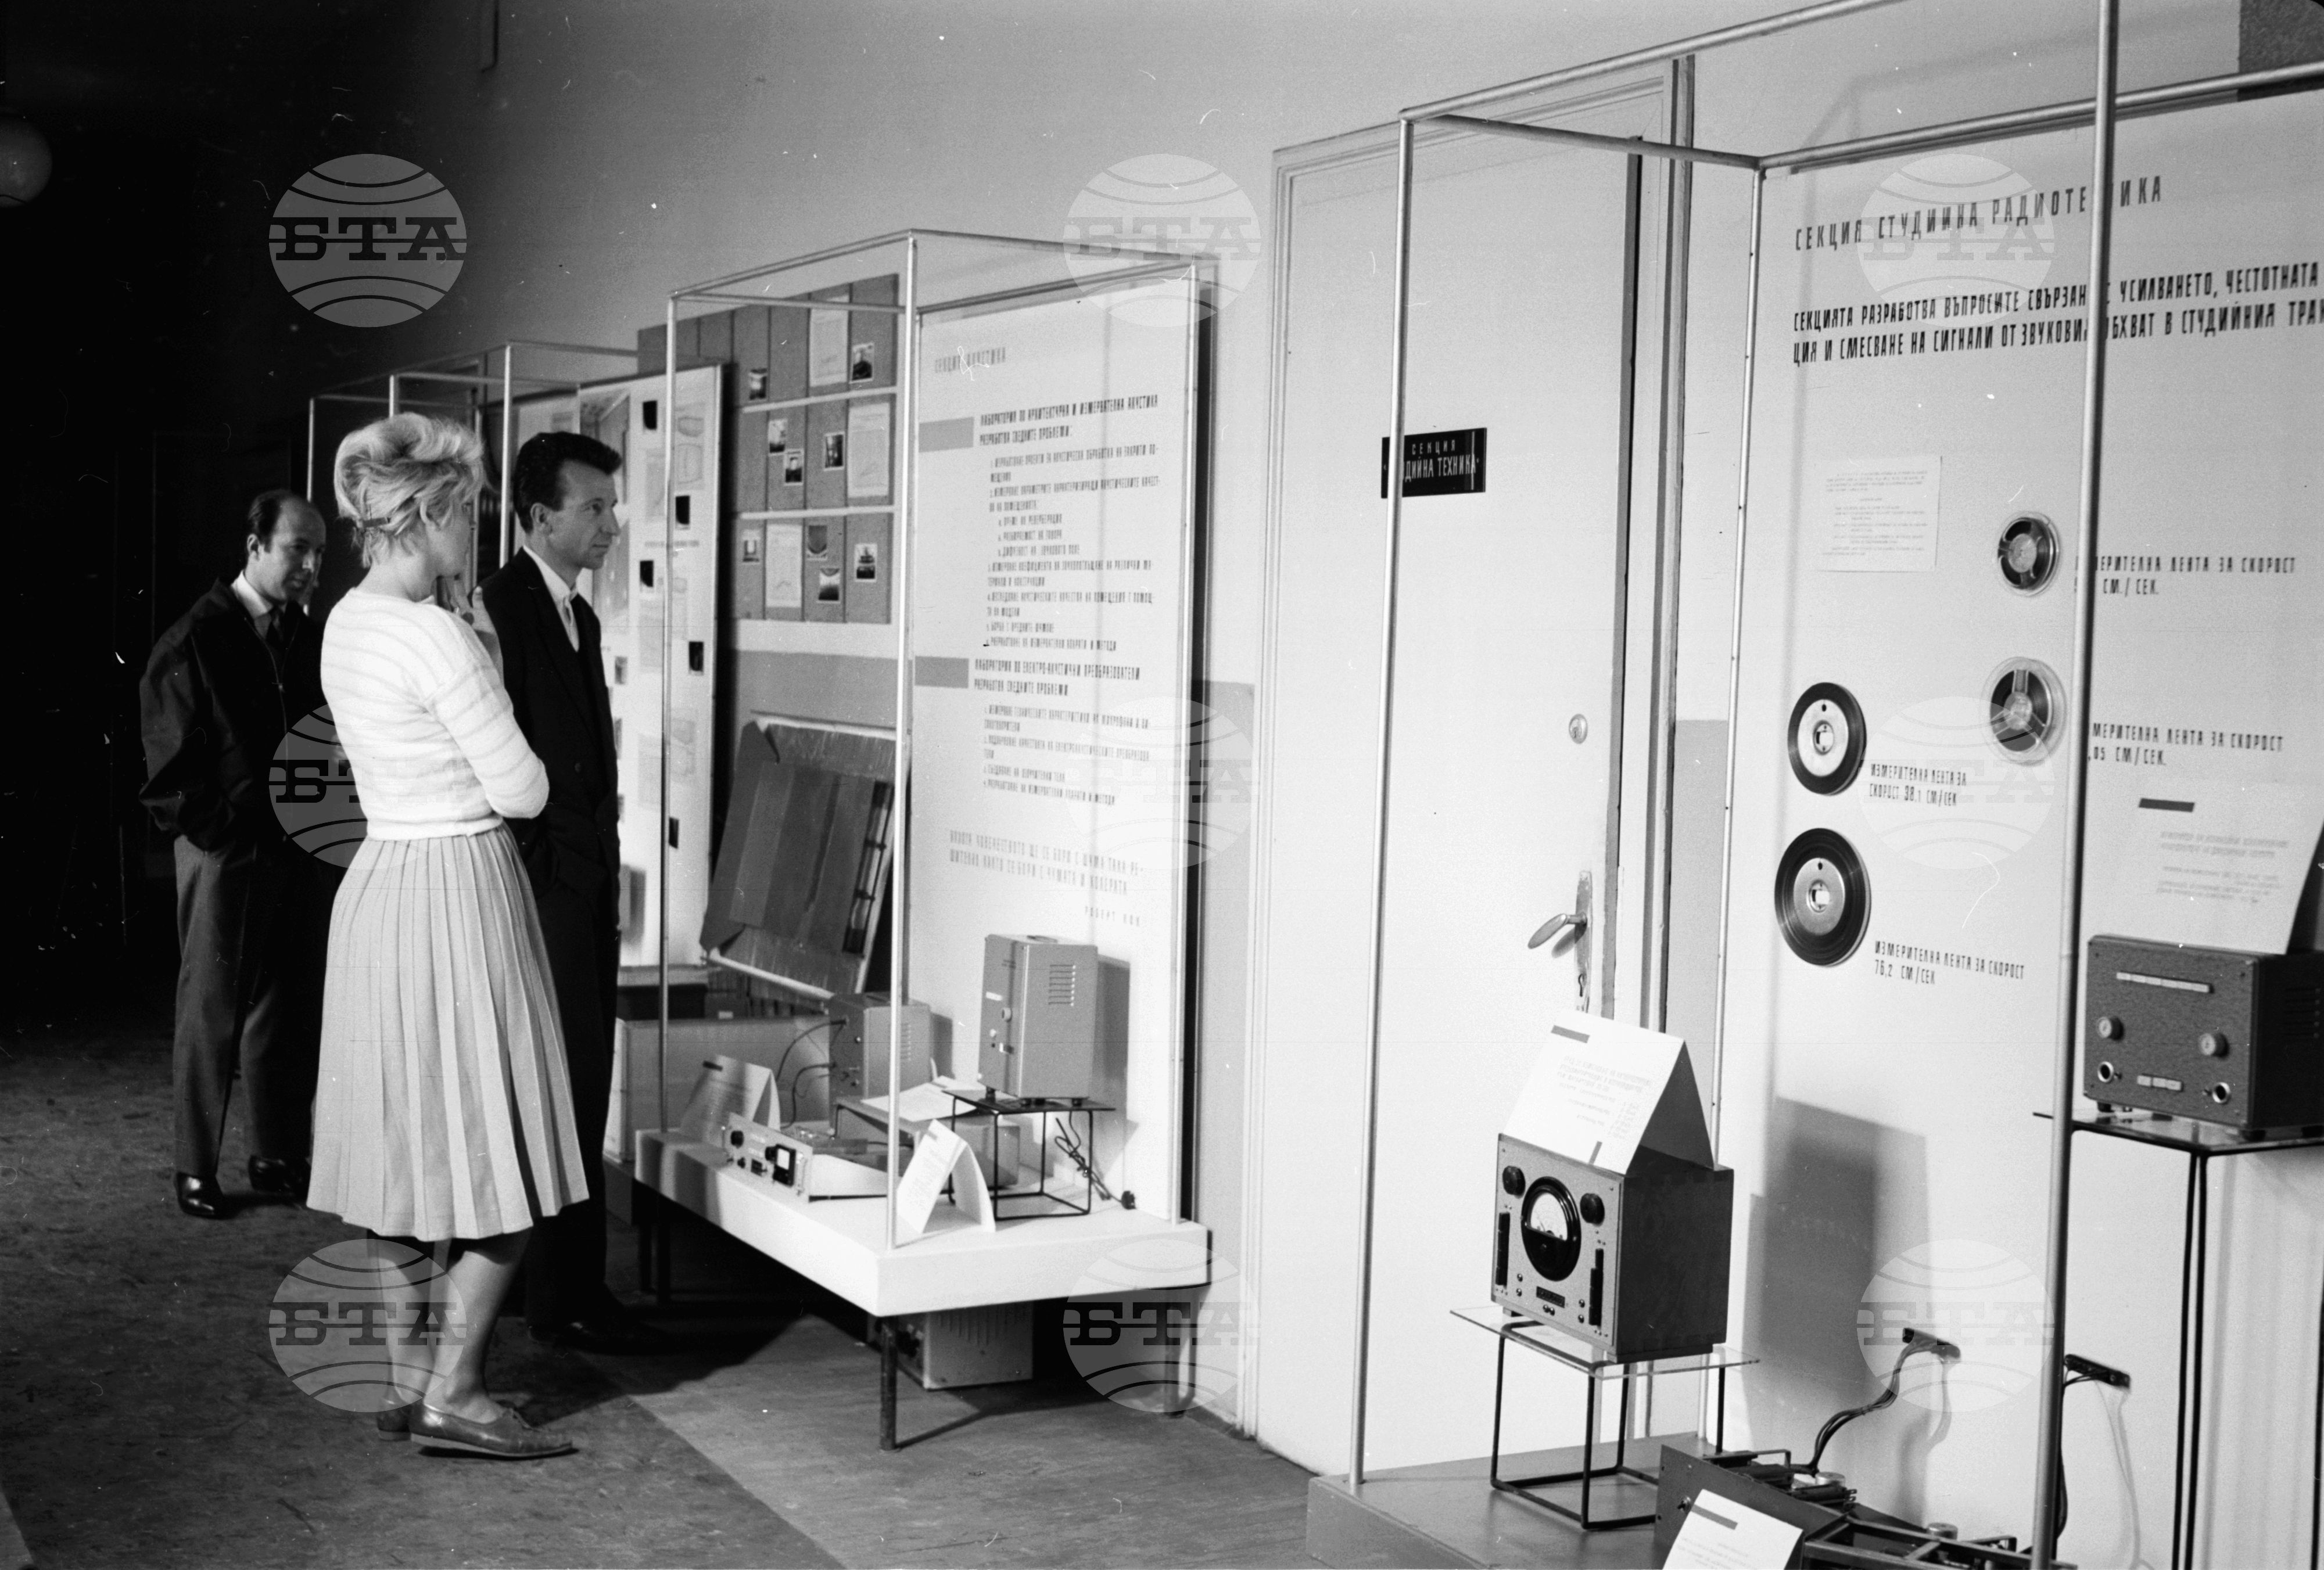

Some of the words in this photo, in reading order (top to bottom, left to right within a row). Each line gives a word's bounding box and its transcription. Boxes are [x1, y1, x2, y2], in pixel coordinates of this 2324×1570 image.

[1796, 220, 1862, 250] СЕКЦИЯ
[1993, 176, 2160, 225] РАДИОТЕИКА
[1794, 307, 1853, 332] СЕКЦИЯТА
[1862, 299, 1935, 325] РАЗРАБОТВА
[1945, 292, 2019, 318] ВЪПРОСИТЕ
[2028, 284, 2087, 311] СВЪРЗАН
[2120, 272, 2218, 303] УСИЛВАНЕТО,
[2226, 262, 2318, 294] ЧЕСТОТНАТА
[1794, 342, 1817, 367] ЦИЯ
[1825, 340, 1832, 361] И
[1840, 333, 1903, 360] СМЕСВАНЕ
[1911, 332, 1925, 354] НА
[1934, 326, 1993, 352] СИГНАЛИ
[2002, 324, 2016, 346] ОТ
[2165, 311, 2172, 335] В
[1412, 440, 1455, 455] СЕКЦИЯ
[2095, 556, 2161, 572] ЕРИТЕЛНА
[2169, 556, 2209, 572] ЛЕНТА
[2219, 556, 2233, 572] ЗА
[2241, 557, 2296, 573] СКОРОСТ
[2092, 723, 2159, 743] МЕРИТЕЛНА
[2166, 728, 2204, 746] ЛЕНТА
[2211, 731, 2224, 748] ЗА
[2230, 733, 2284, 752] СКОРОСТ
[1871, 764, 1928, 782] ИЗМЕРИТЕЛНА
[1931, 769, 1954, 785] ЛЕНТА
[1957, 771, 1967, 786] ЗА
[1870, 783, 1899, 800] СКОРОСТ
[1927, 789, 1956, 807] СМ/СЕК
[1875, 940, 1940, 965] ИЗМЕРИТЕЛНА
[1944, 953, 1971, 971] ЛЕНТА
[1975, 958, 1985, 973] ЗА
[1989, 960, 2025, 980] СКОРОСТ
[1901, 965, 1935, 985] СМ/СЕК
